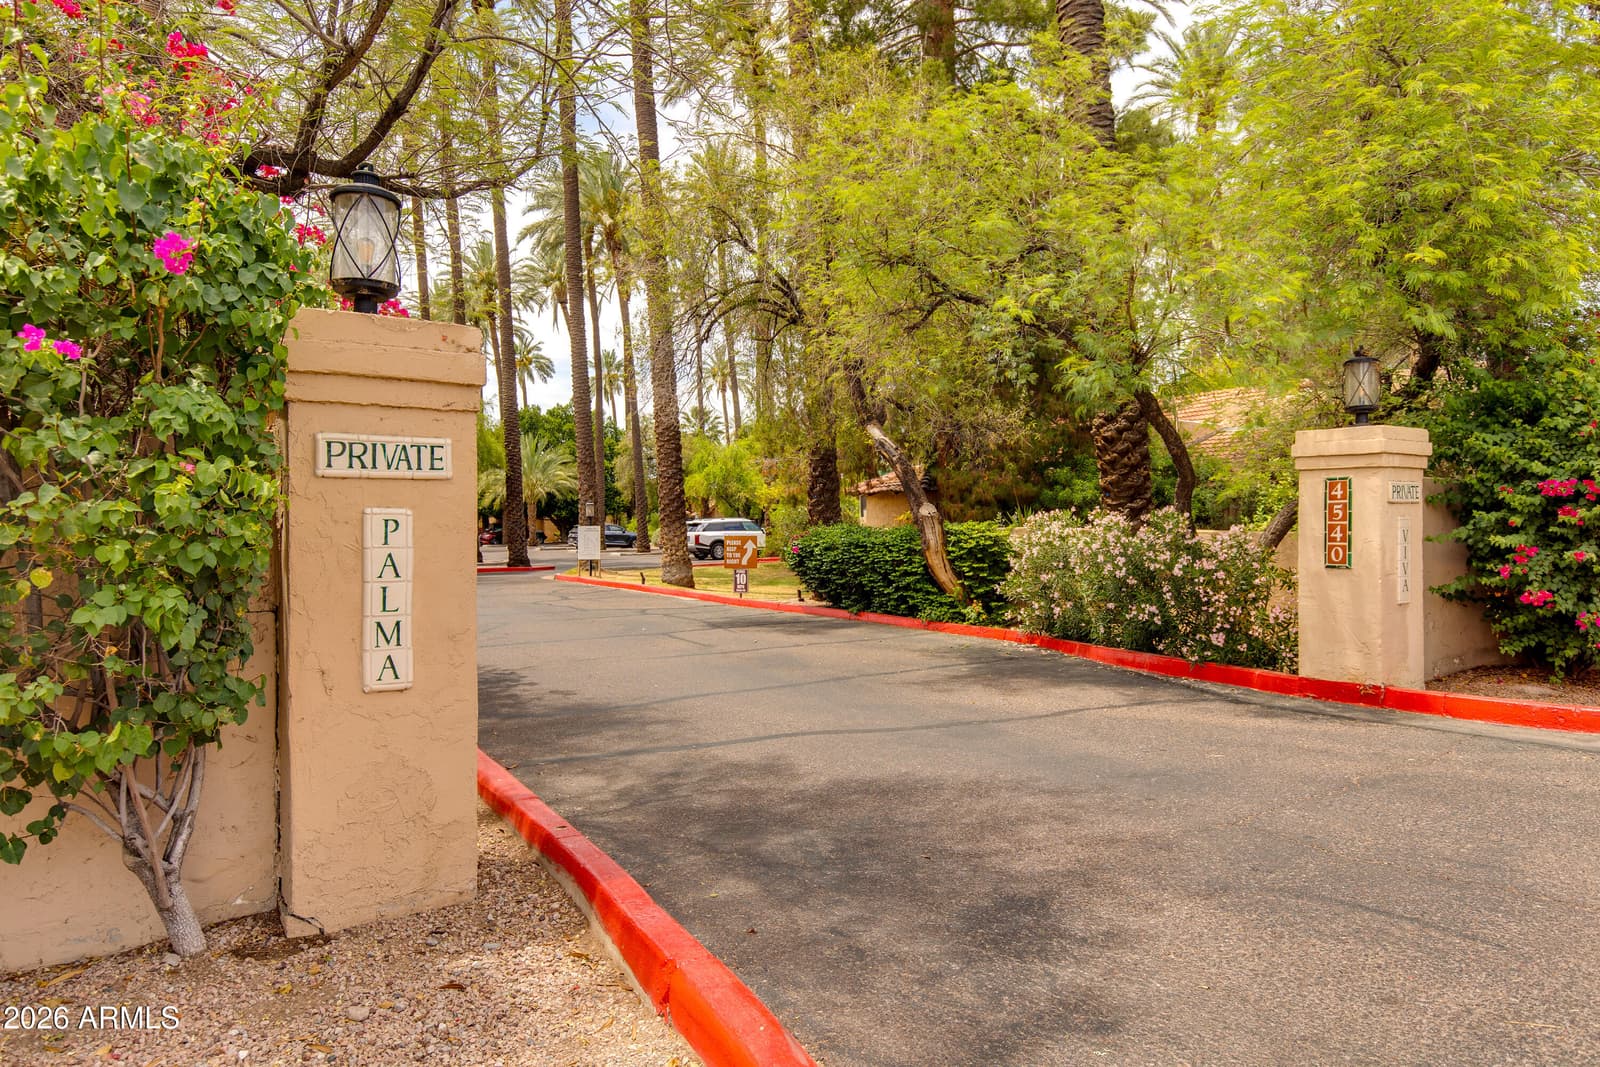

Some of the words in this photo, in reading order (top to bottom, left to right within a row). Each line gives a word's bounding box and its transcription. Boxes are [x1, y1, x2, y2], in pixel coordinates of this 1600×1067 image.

[325, 440, 444, 471] PRIVATE
[1392, 485, 1419, 500] PRIVATE
[1330, 482, 1344, 562] 4540
[735, 573, 747, 585] 10
[374, 518, 402, 682] PALMA
